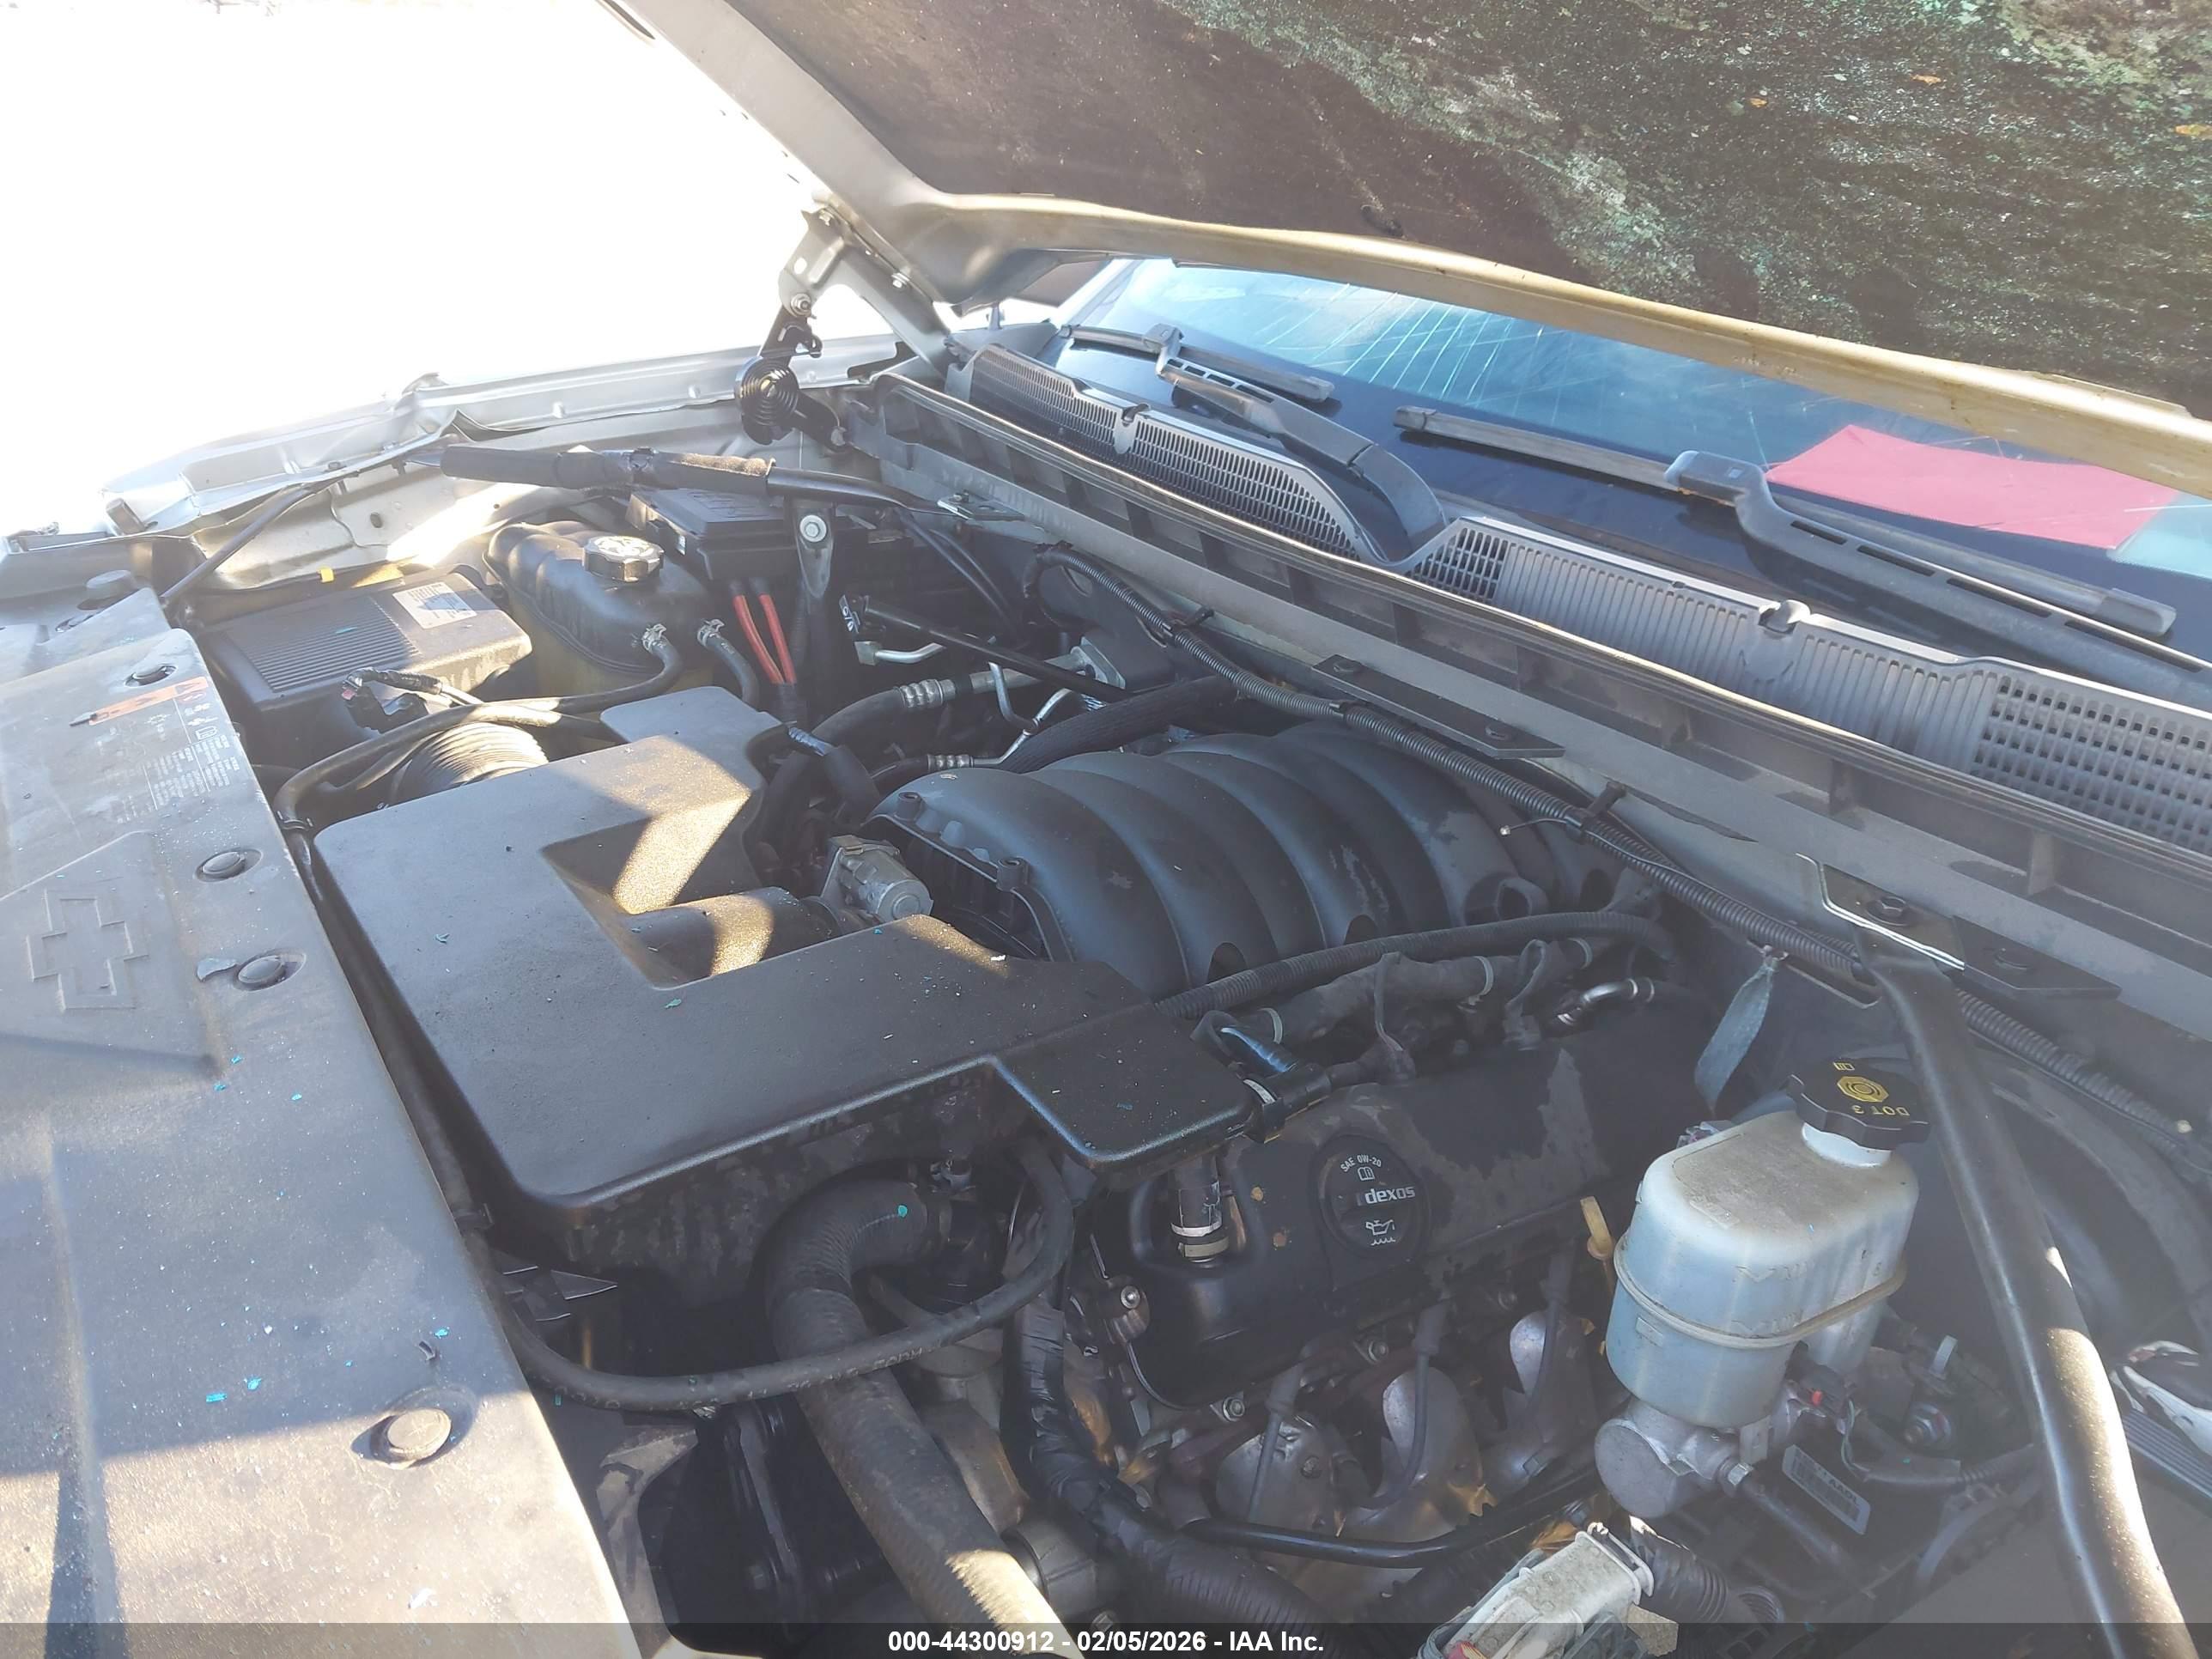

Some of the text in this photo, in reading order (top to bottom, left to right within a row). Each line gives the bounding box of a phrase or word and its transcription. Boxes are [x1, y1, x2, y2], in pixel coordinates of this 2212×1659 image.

[1852, 1105, 1911, 1115] DOT 3
[1340, 1154, 1381, 1172] SAE 0W-20
[1365, 1186, 1415, 1204] dexos
